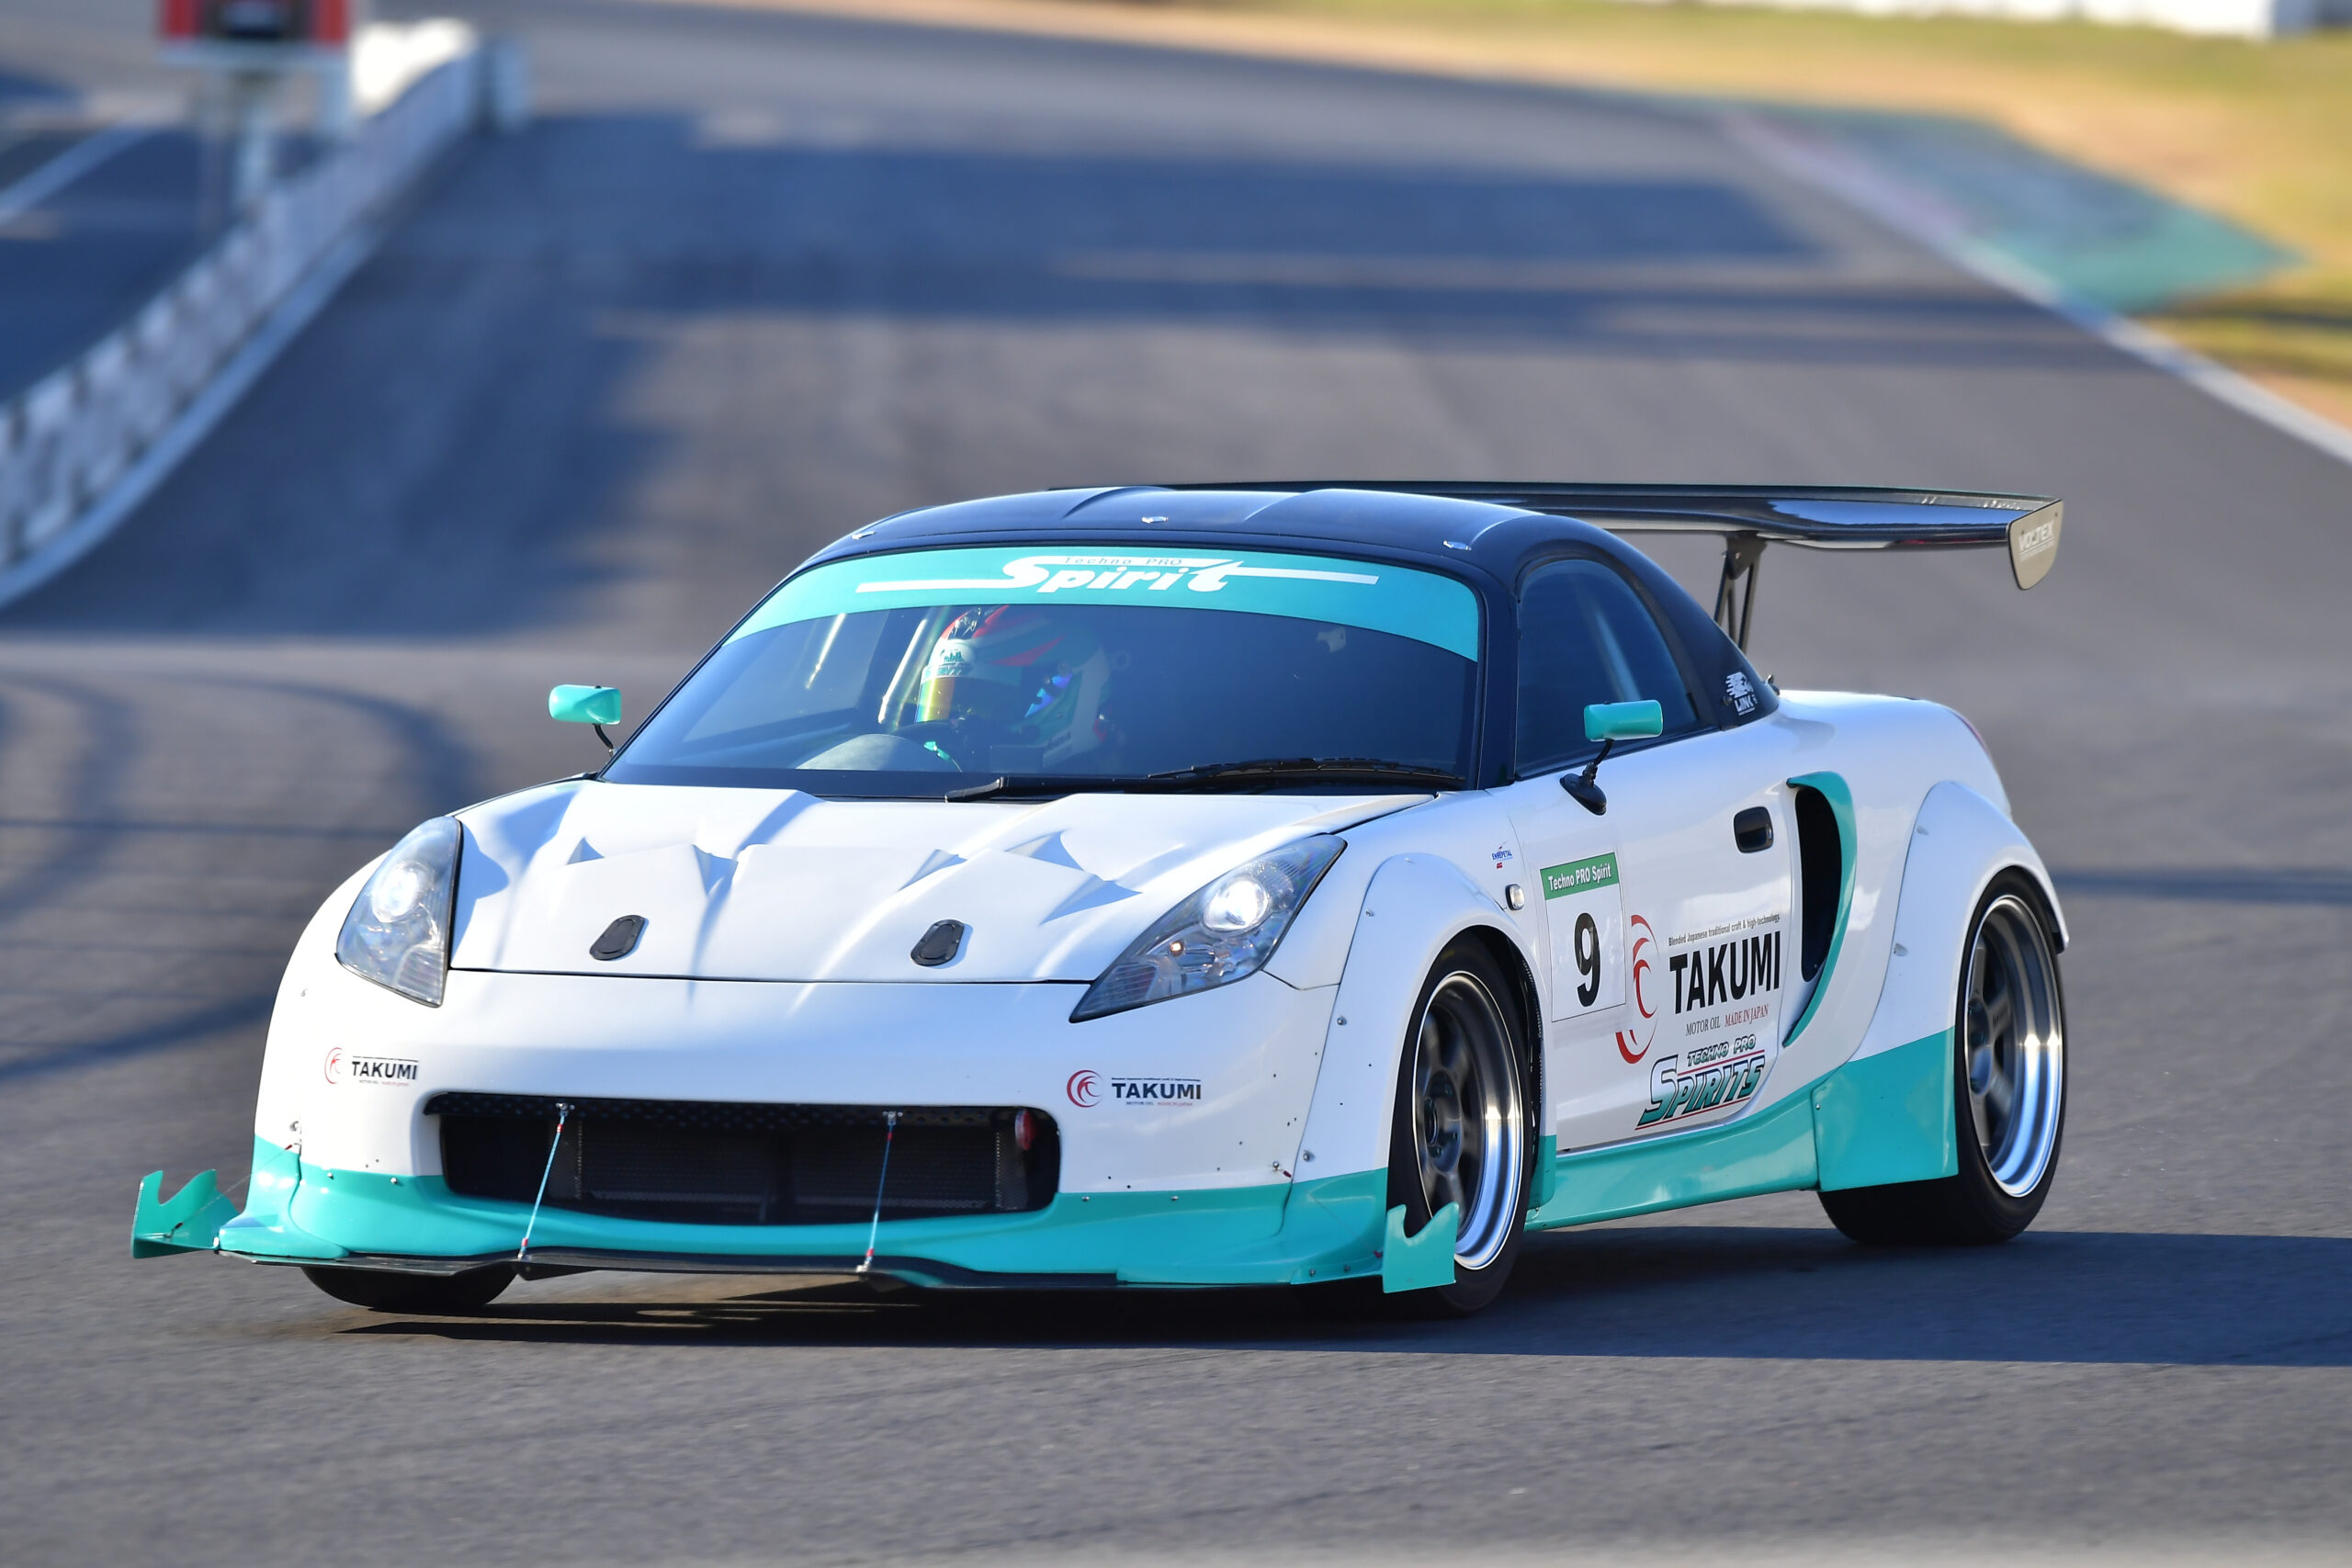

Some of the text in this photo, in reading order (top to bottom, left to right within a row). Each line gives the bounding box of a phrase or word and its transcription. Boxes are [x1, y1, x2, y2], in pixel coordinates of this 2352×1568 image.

[1002, 556, 1244, 593] Spirit
[1146, 558, 1182, 566] PRO
[1548, 863, 1611, 891] Techno PRO Spirit
[1668, 914, 1781, 946] Blended Japanese traditional craft & high-technology
[1574, 912, 1601, 1007] 9
[1669, 931, 1781, 1015] TAKUMI
[1686, 1004, 1769, 1036] MOTOR OIL MADE IN JAPAN
[1688, 1033, 1757, 1066] TECHNO PRO
[352, 1061, 418, 1080] TAKUMI
[1112, 1082, 1201, 1100] TAKUMI
[1636, 1055, 1766, 1127] SPIRITS
